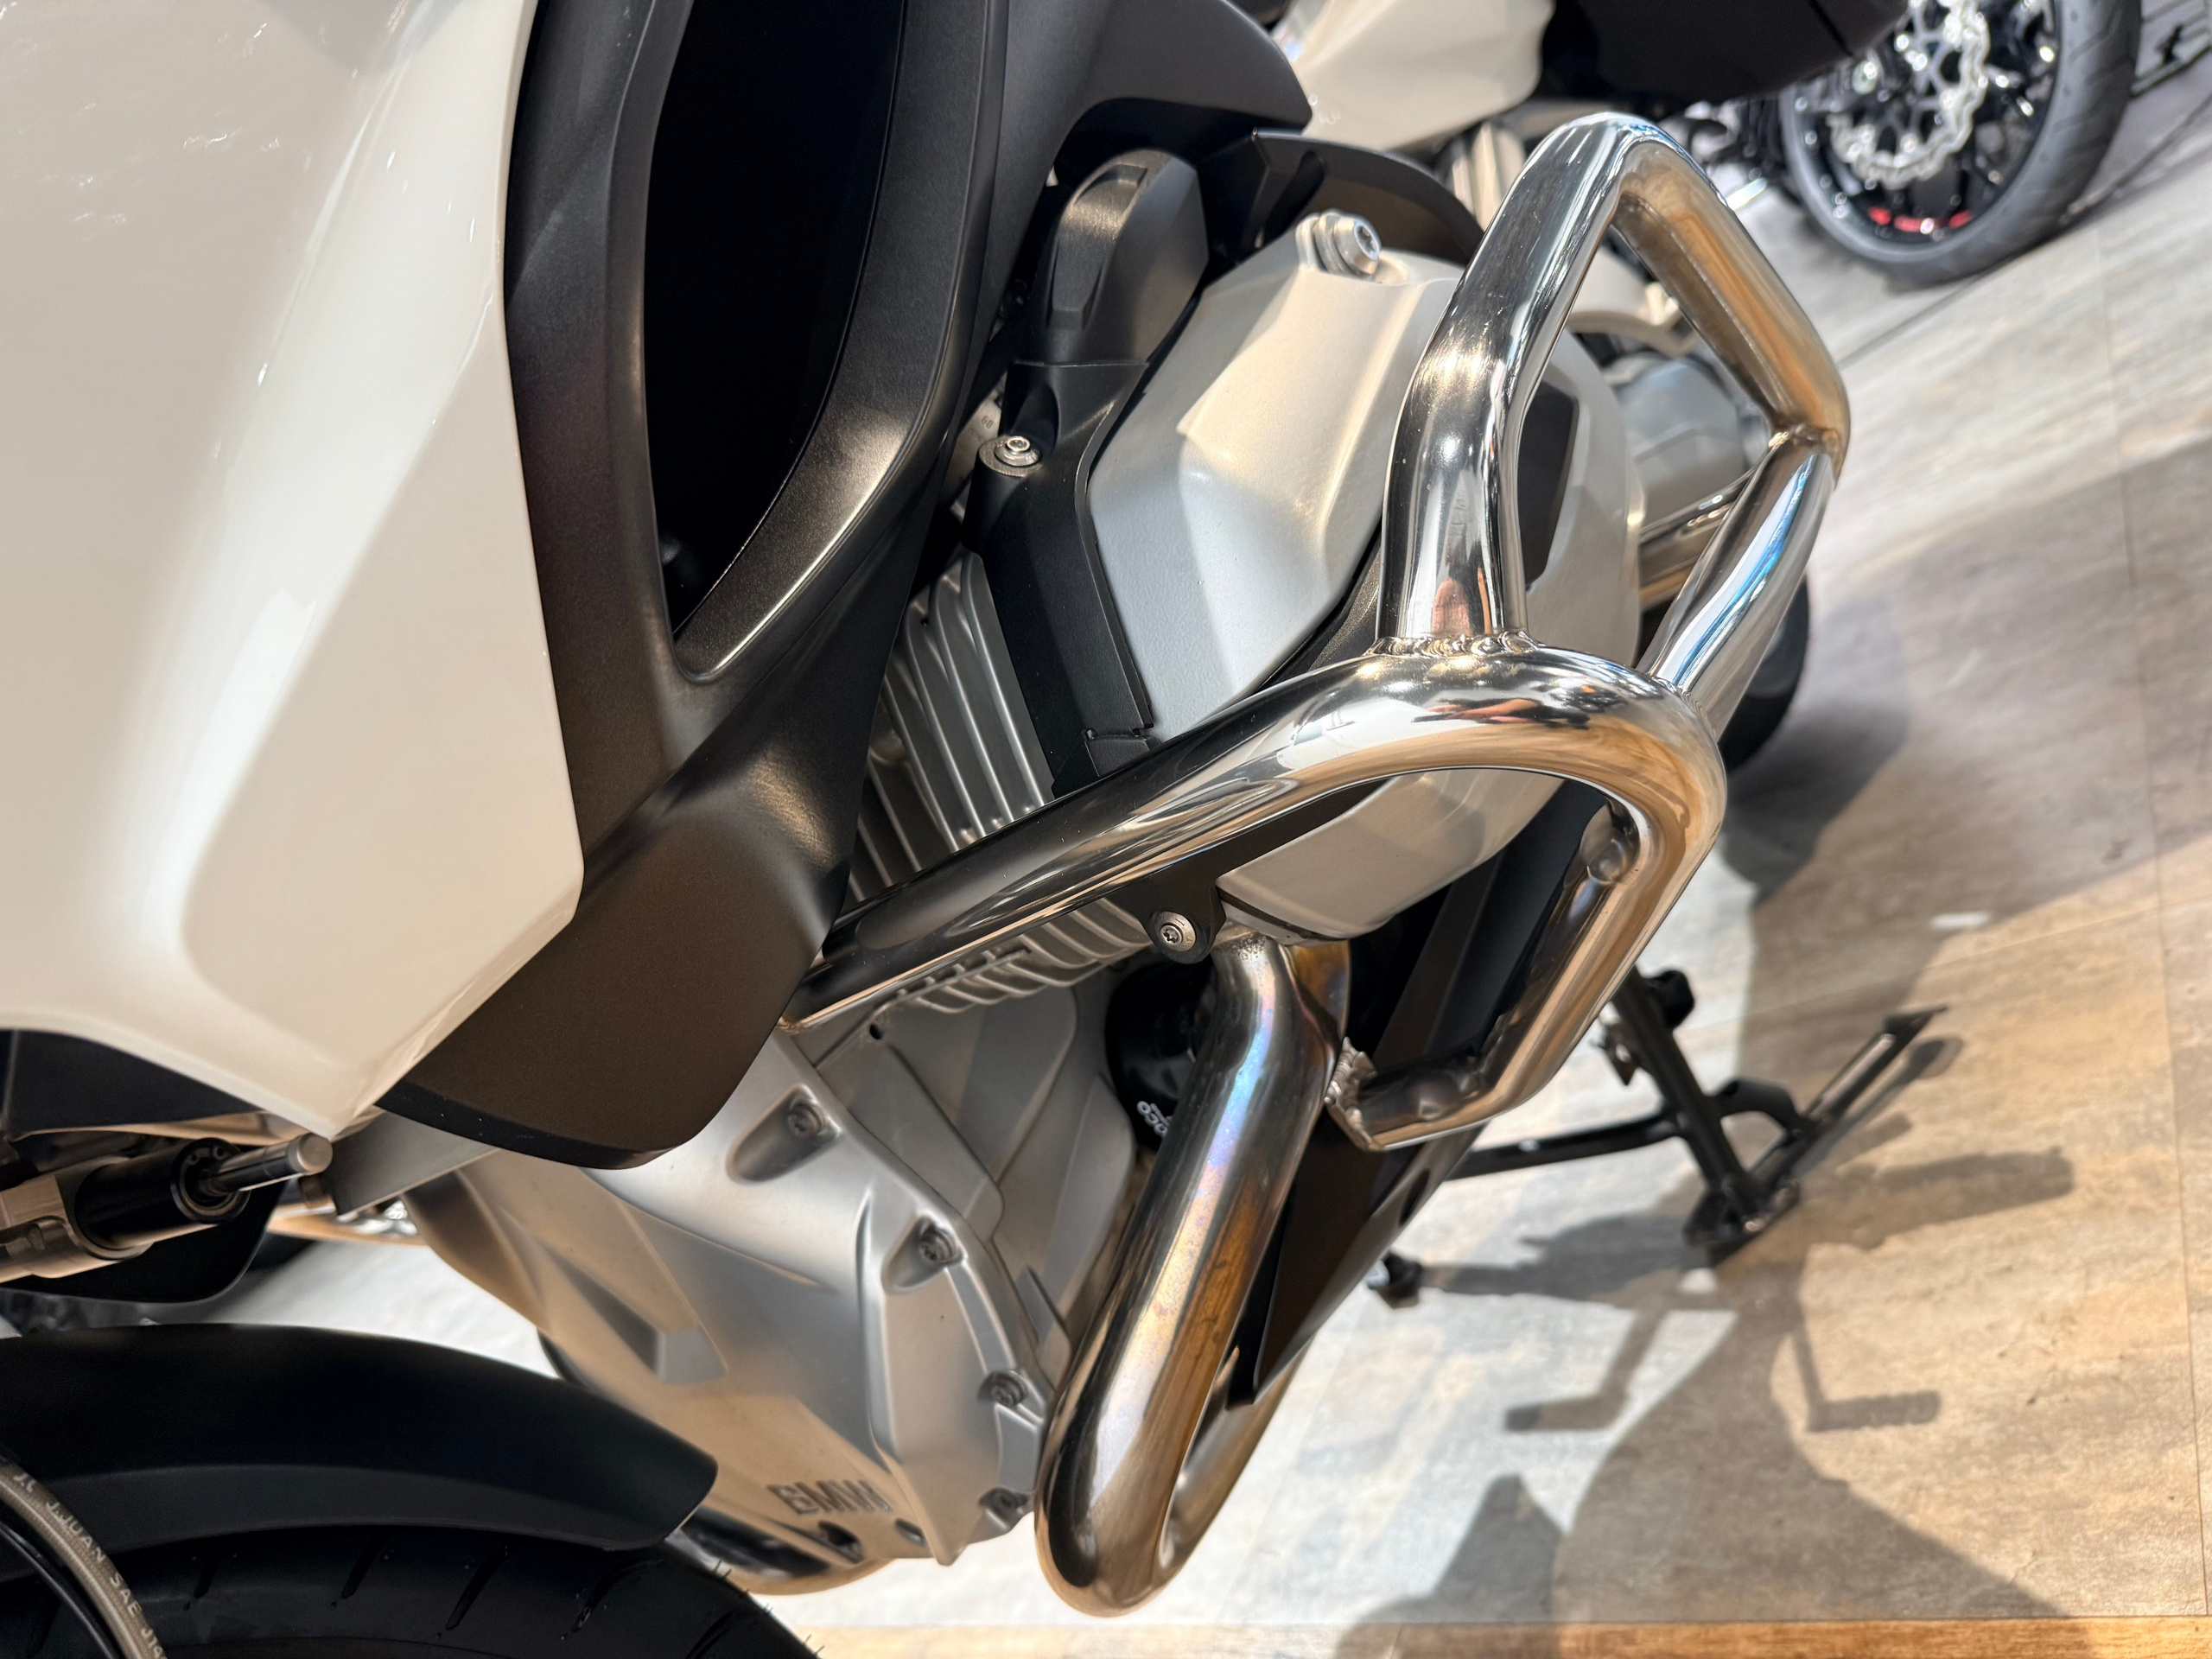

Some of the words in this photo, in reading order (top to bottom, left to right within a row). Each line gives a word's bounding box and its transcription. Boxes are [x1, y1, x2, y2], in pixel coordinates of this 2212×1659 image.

[766, 1478, 893, 1515] BMW
[110, 1572, 142, 1617] SAE
[141, 1628, 168, 1659] J14
